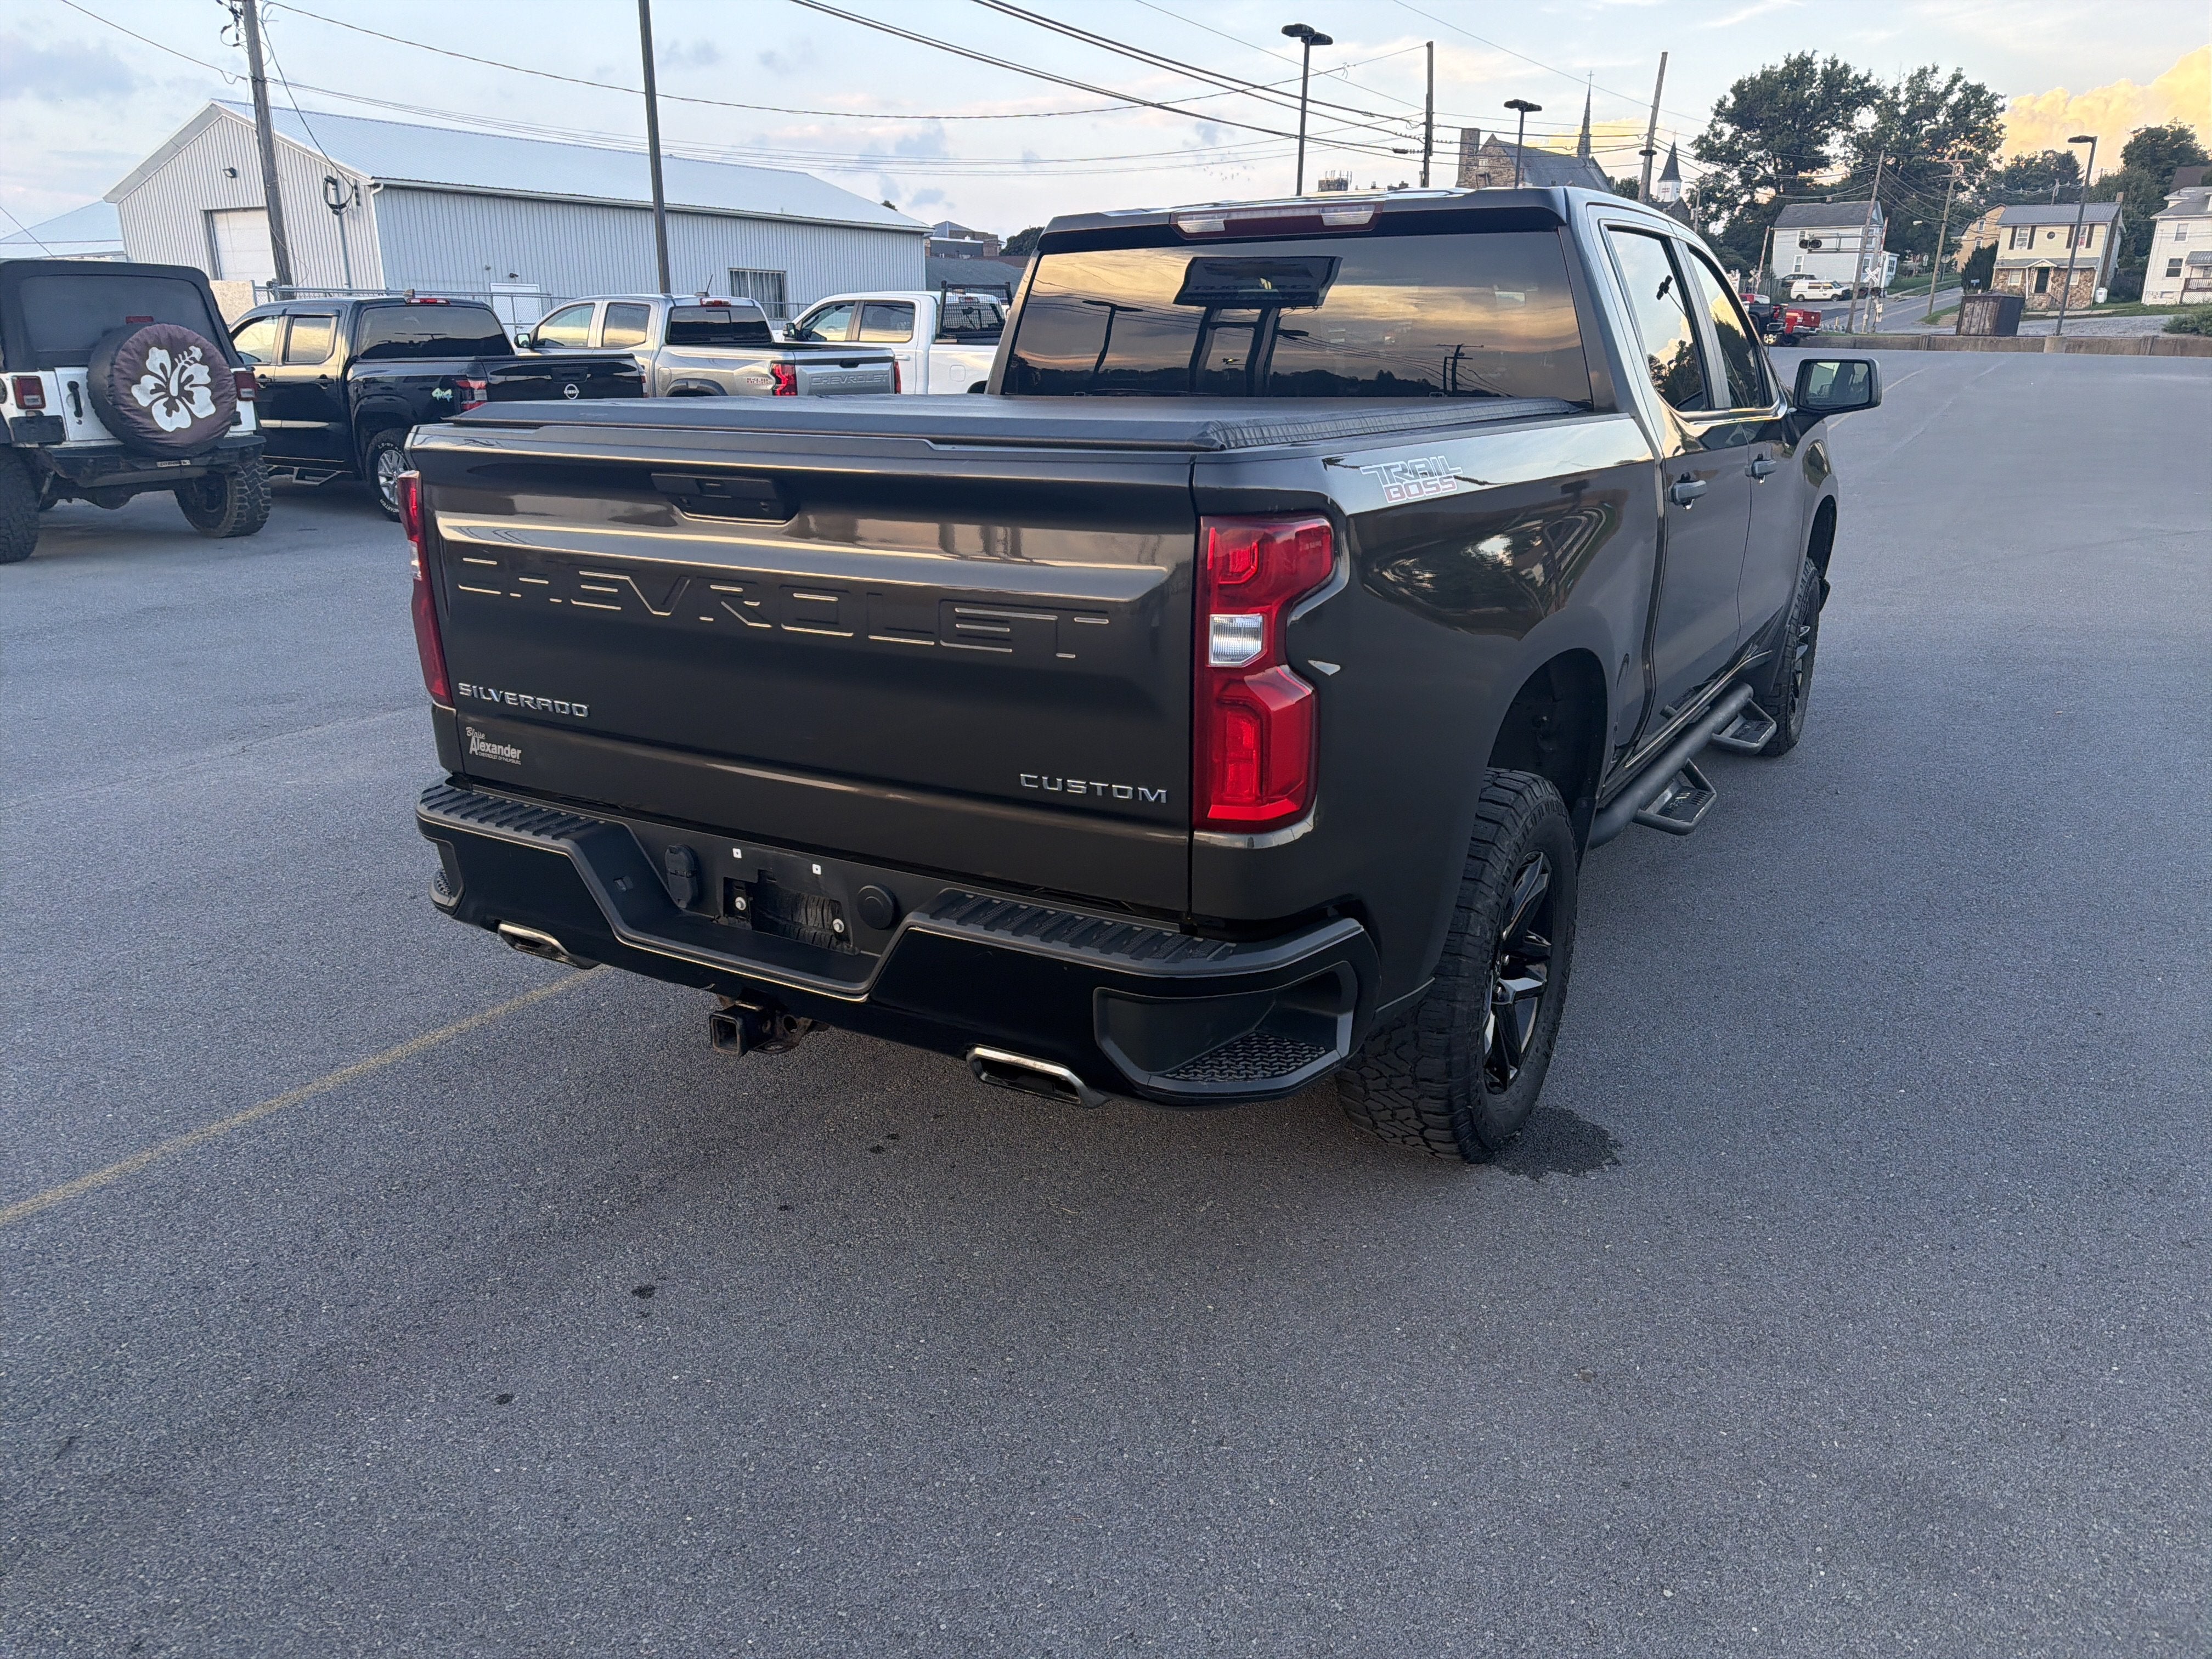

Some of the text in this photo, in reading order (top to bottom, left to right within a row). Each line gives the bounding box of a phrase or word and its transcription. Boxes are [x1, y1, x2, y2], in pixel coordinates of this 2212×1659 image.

[811, 374, 888, 385] CHEVROLET
[1360, 455, 1463, 486] TRAIL
[1384, 475, 1458, 503] BOSS
[458, 550, 1110, 658] CHEVROLET
[458, 682, 589, 718] SILVERADO
[465, 726, 485, 740] Blaise
[469, 737, 522, 760] Alexander
[1020, 774, 1167, 803] CUSTOM
